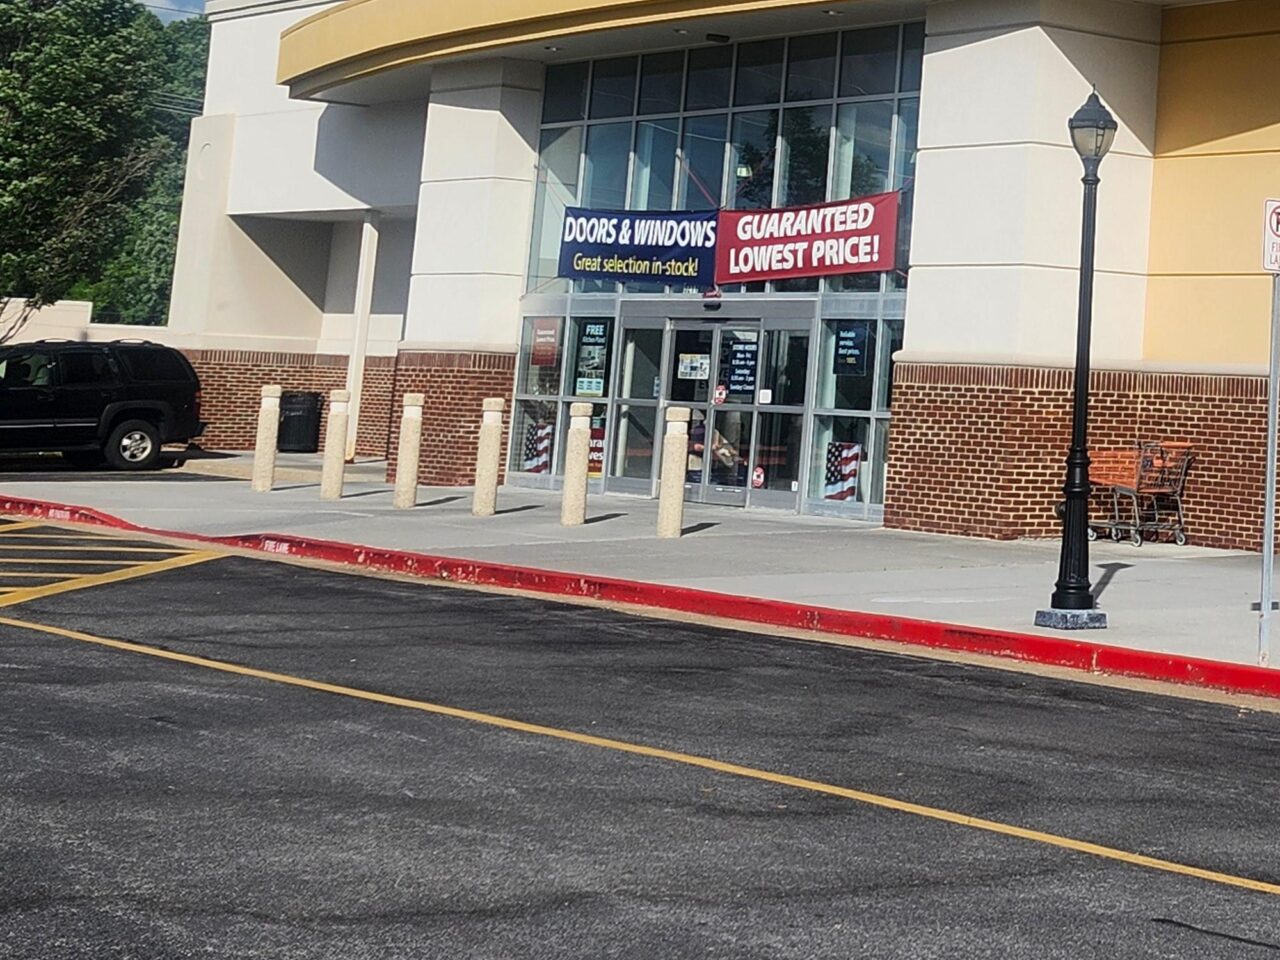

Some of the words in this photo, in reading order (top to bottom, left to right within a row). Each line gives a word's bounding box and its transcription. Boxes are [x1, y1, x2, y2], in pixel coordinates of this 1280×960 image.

[564, 216, 618, 243] DOORS
[619, 218, 632, 245] &
[634, 219, 717, 248] WINDOWS
[737, 202, 875, 240] GUARANTEED
[573, 252, 601, 271] Great
[603, 254, 650, 274] selection
[651, 256, 699, 276] in-stock!
[729, 242, 809, 274] LOWEST
[812, 234, 880, 267] PRICE!
[585, 324, 605, 336] FREE
